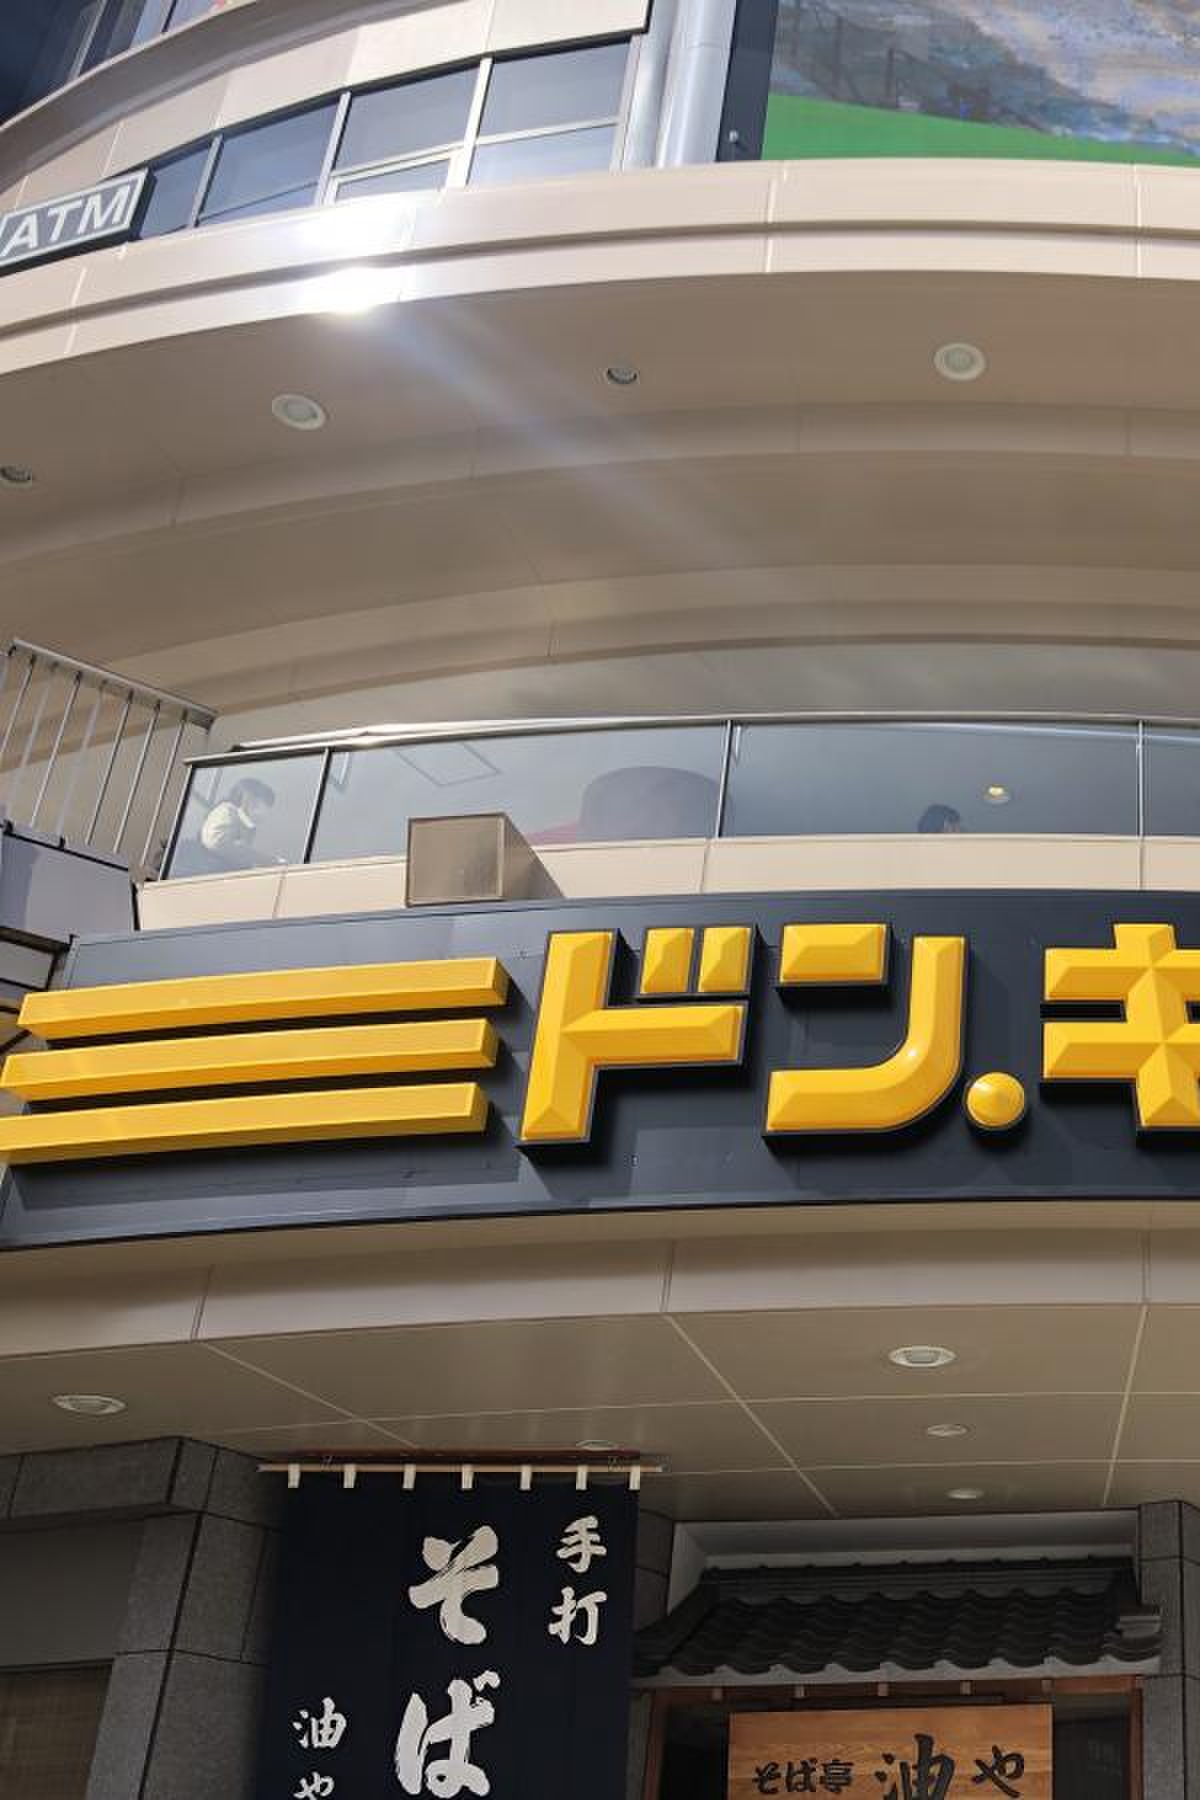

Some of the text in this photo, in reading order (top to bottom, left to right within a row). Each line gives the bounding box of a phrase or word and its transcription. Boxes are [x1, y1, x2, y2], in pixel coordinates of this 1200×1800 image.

[0, 184, 131, 257] ATM
[548, 1514, 608, 1645] 手打
[395, 1524, 501, 1799] そば
[752, 1757, 854, 1795] そば亭
